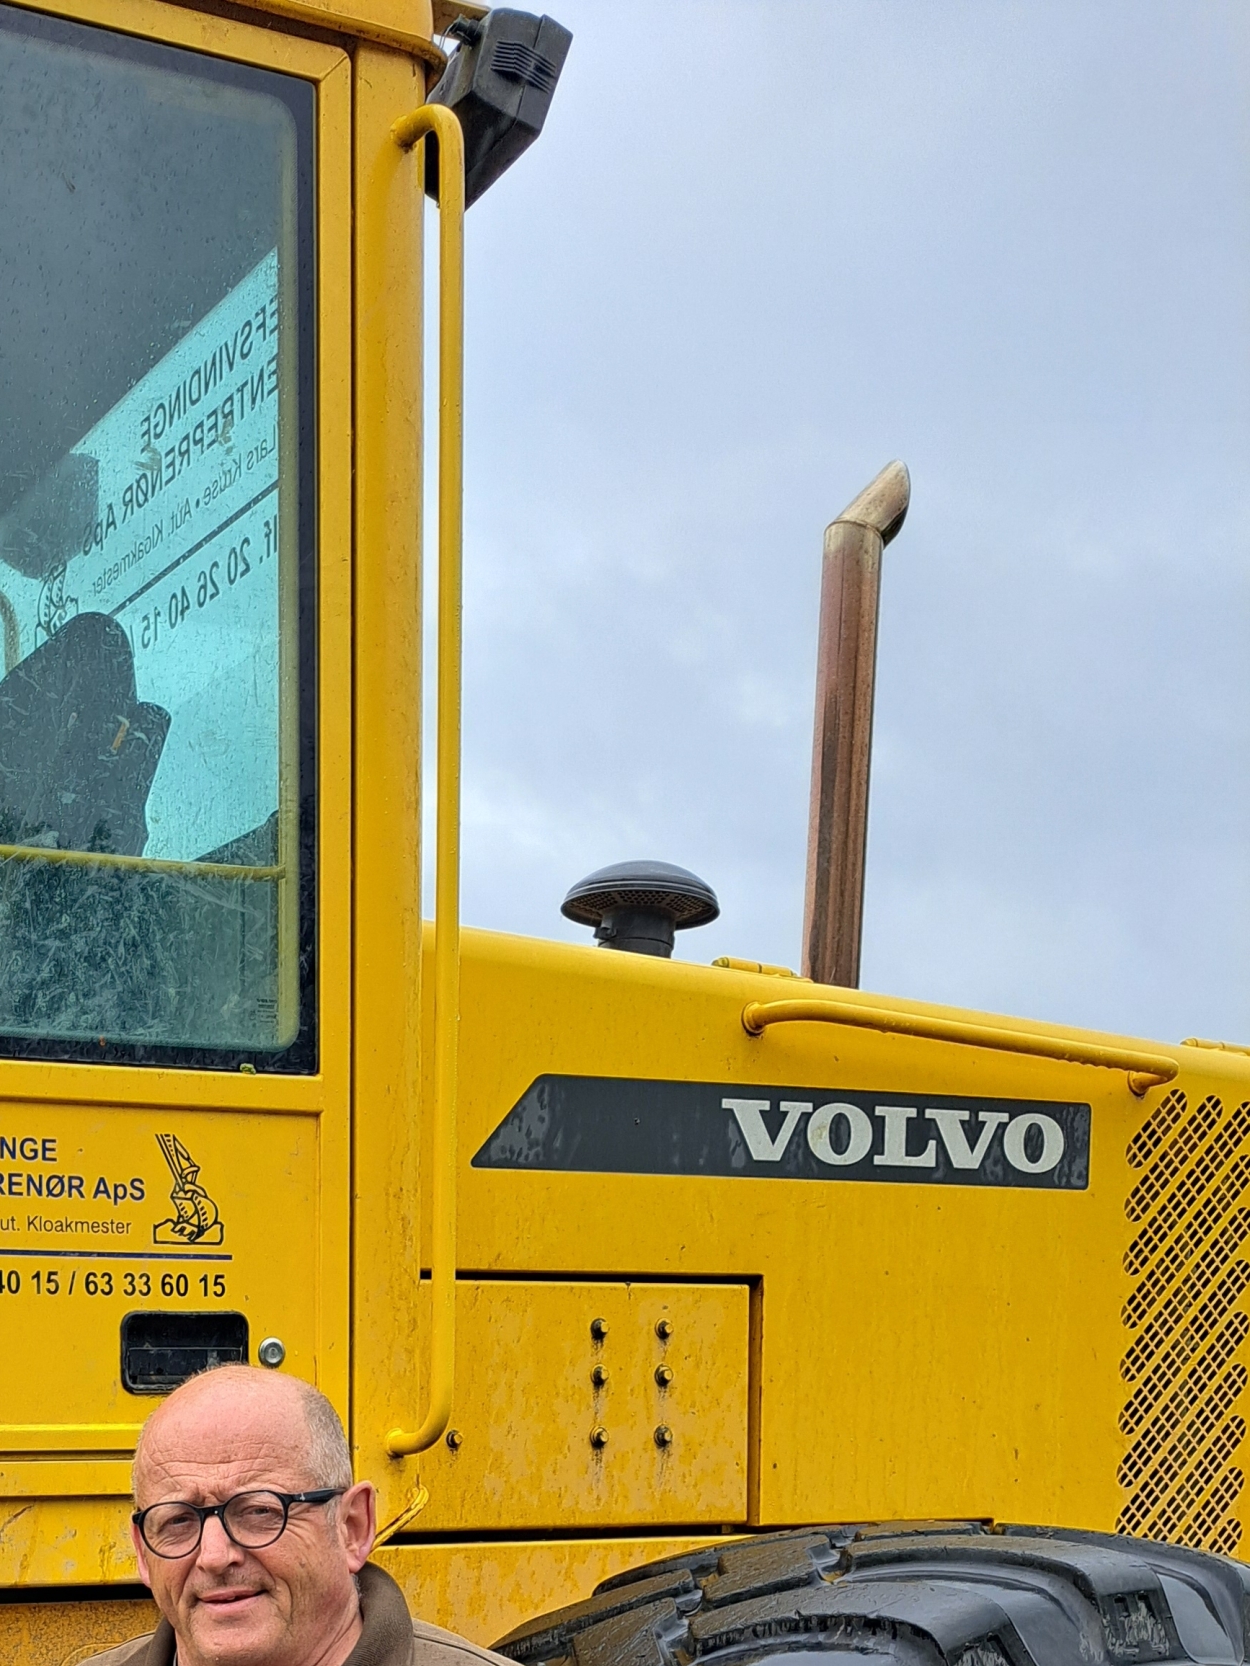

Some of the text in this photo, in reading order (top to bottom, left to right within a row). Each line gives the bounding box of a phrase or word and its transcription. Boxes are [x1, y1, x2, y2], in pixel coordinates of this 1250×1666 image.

[721, 1097, 1065, 1174] VOLVO
[92, 1177, 146, 1206] ApS
[26, 1214, 132, 1235] Kloakmester
[31, 1270, 60, 1296] 15
[84, 1271, 114, 1296] 63
[123, 1272, 152, 1298] 33
[160, 1273, 189, 1298] 60
[199, 1273, 226, 1298] 15
